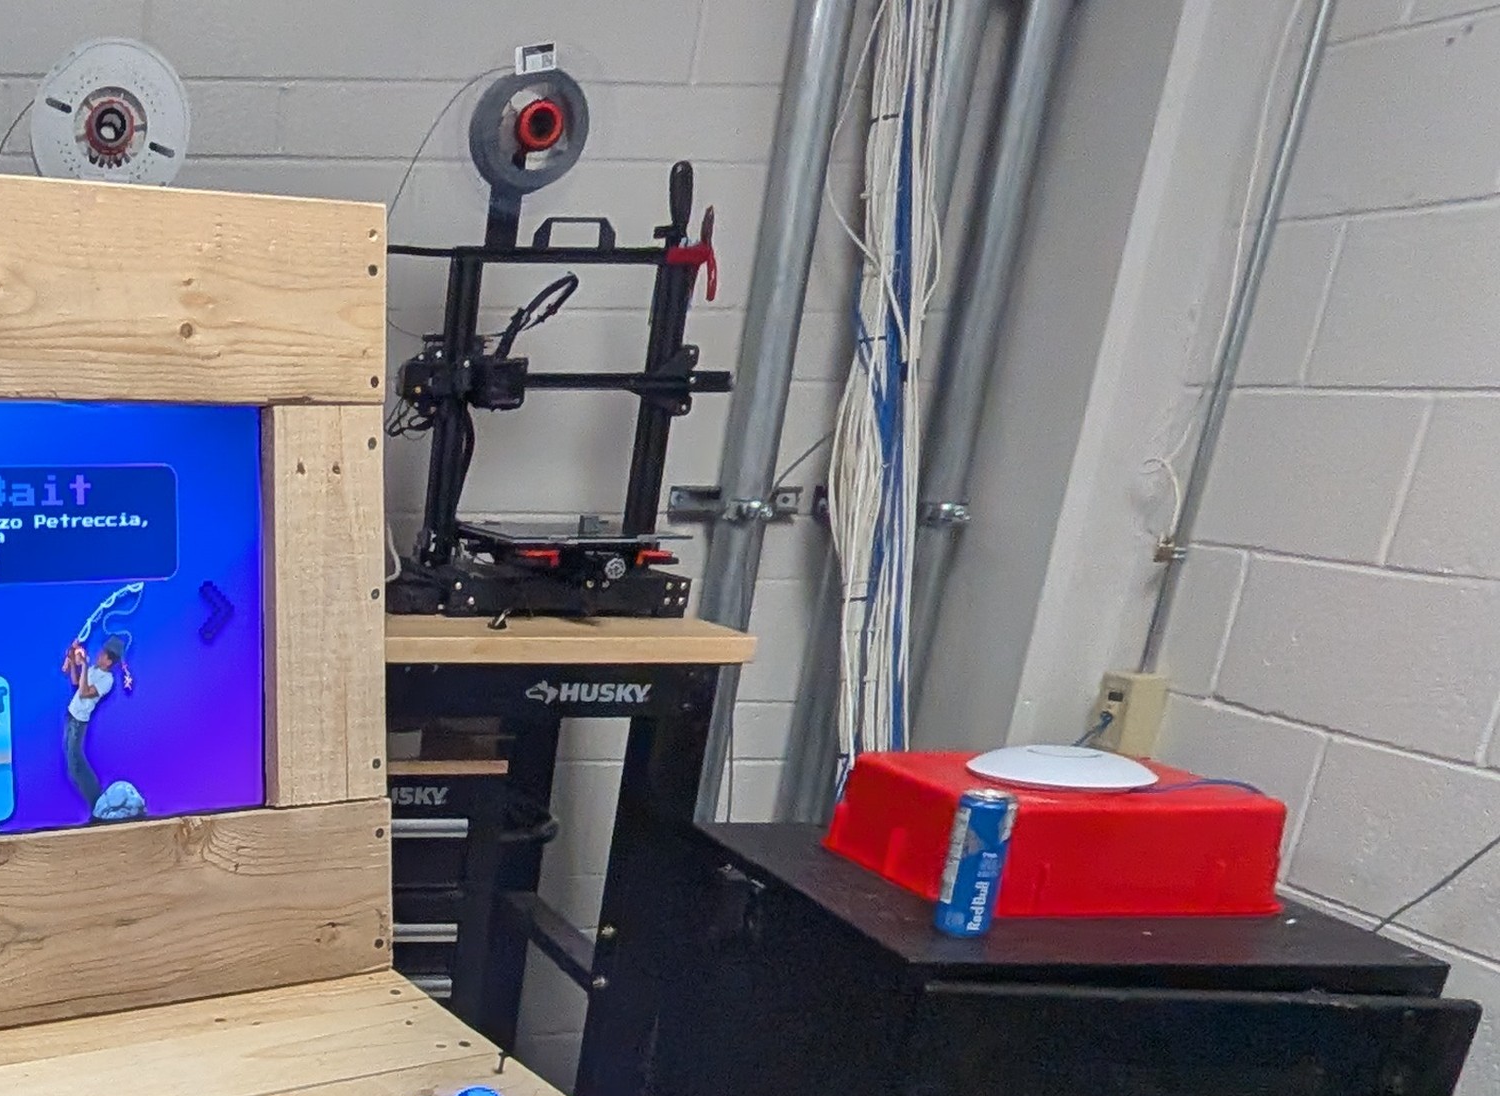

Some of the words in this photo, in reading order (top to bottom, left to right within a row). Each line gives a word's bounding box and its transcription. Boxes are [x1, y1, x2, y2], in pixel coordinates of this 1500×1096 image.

[34, 513, 149, 529] Petreccia,
[558, 683, 652, 703] HUSKY
[392, 787, 449, 805] SKY
